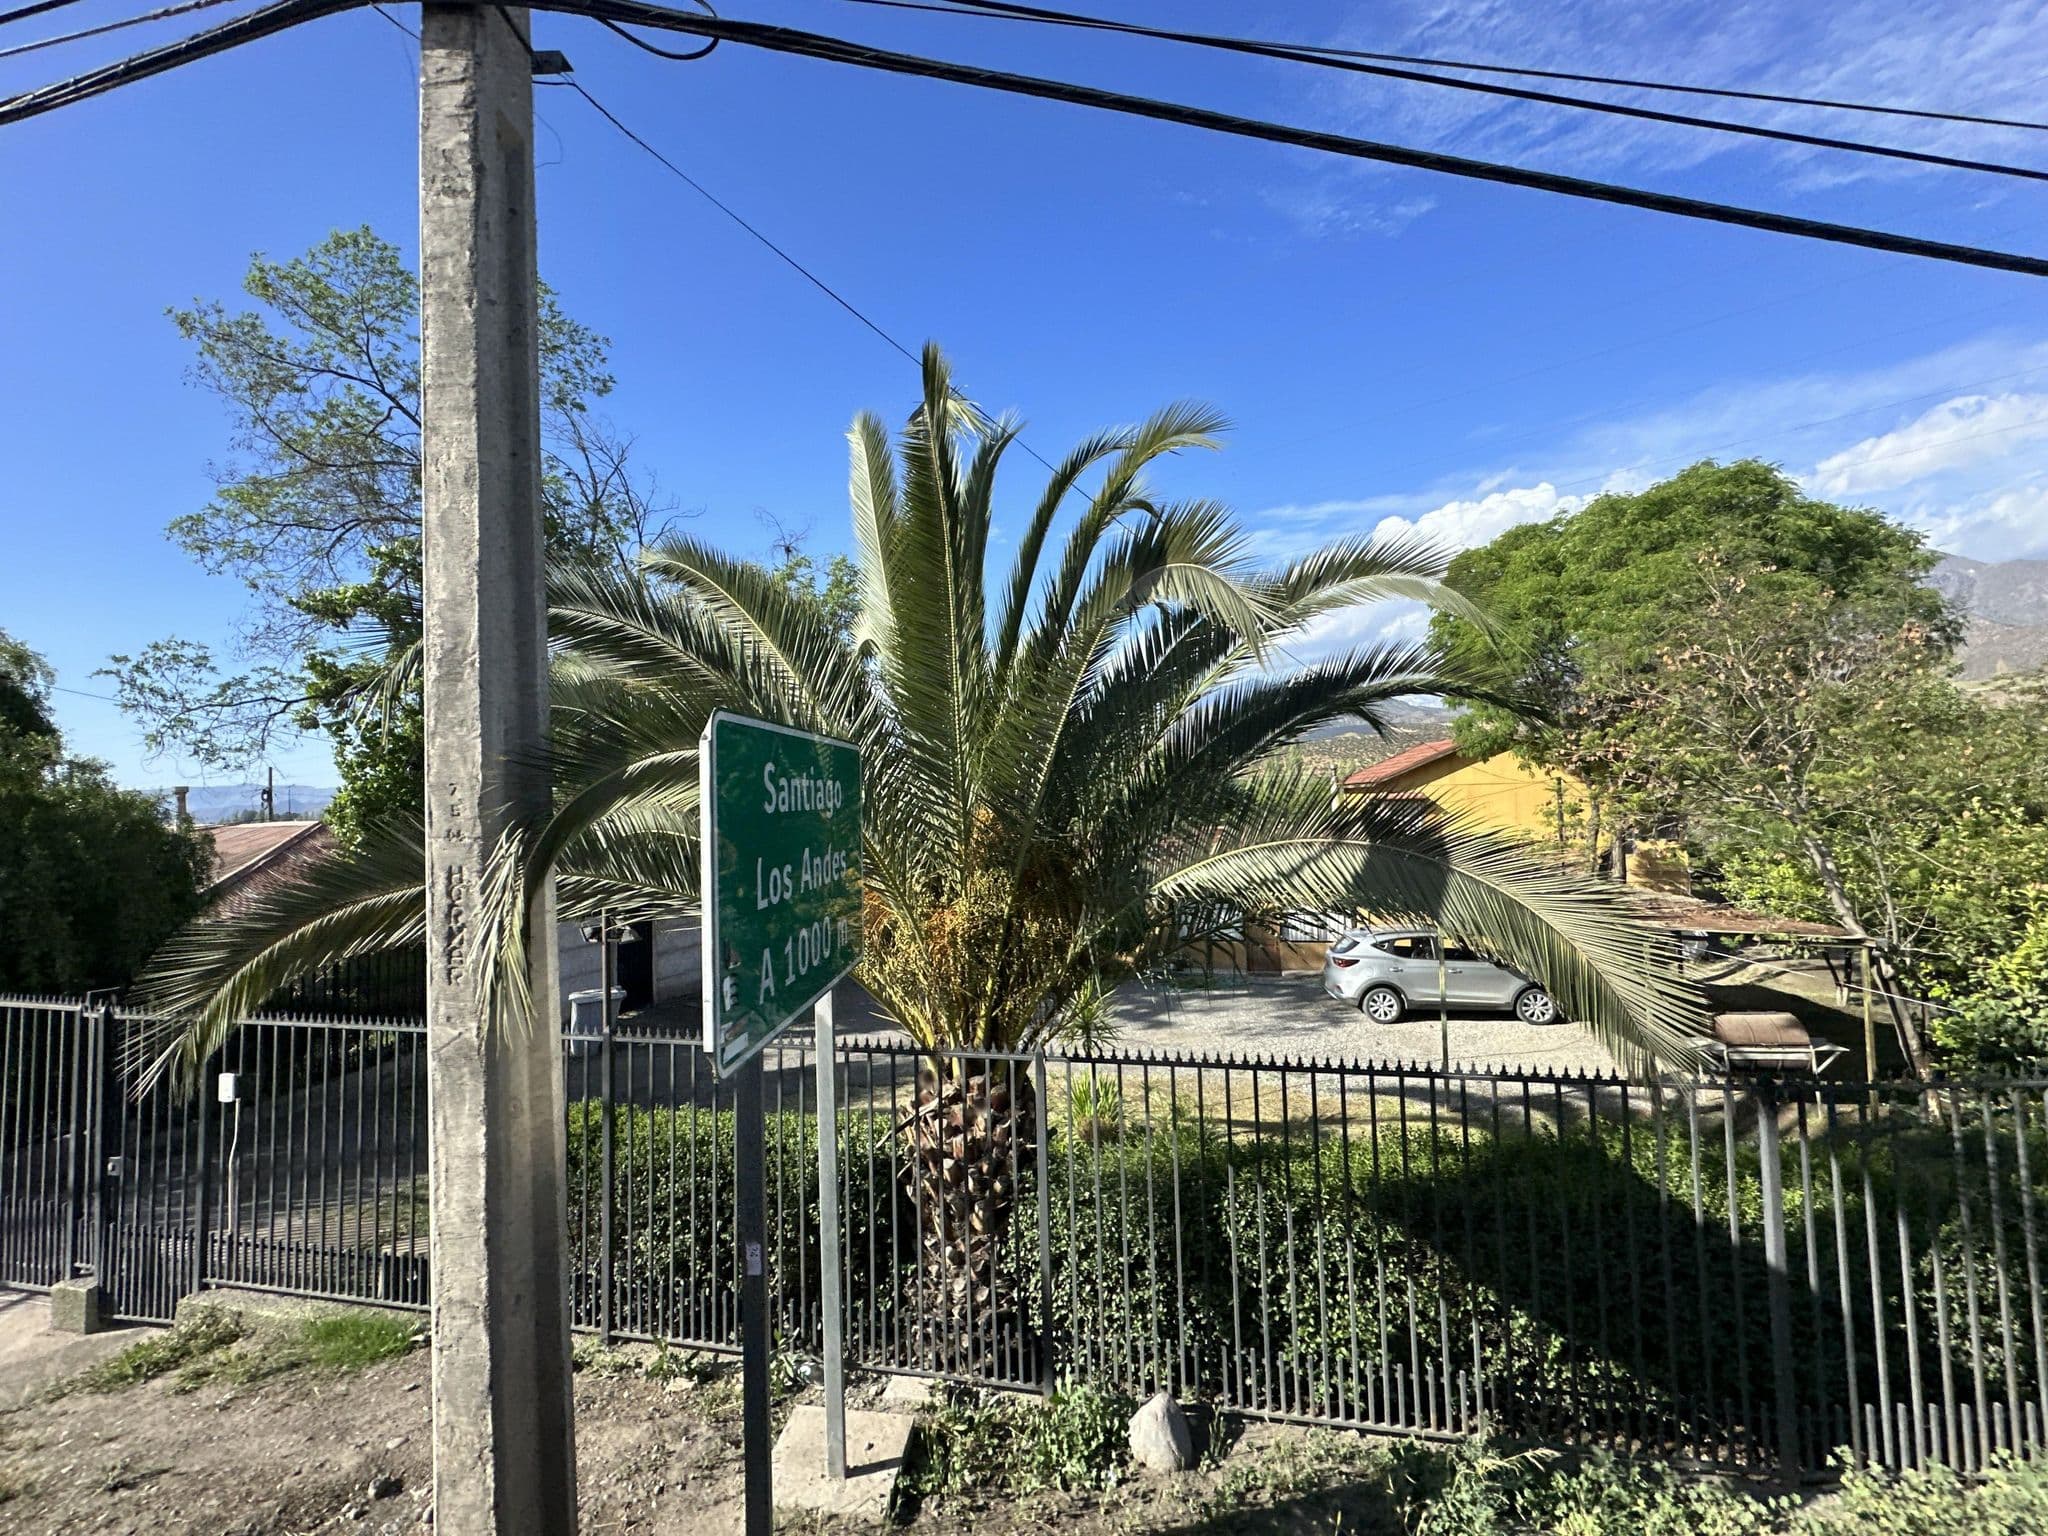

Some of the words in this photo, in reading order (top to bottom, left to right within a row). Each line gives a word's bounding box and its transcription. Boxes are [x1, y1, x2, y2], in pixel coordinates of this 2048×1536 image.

[763, 761, 842, 819] Santiago
[757, 857, 793, 911] Los
[800, 842, 847, 894] Andes
[760, 947, 775, 1005] A
[784, 915, 831, 987] 1000
[837, 917, 848, 950] m
